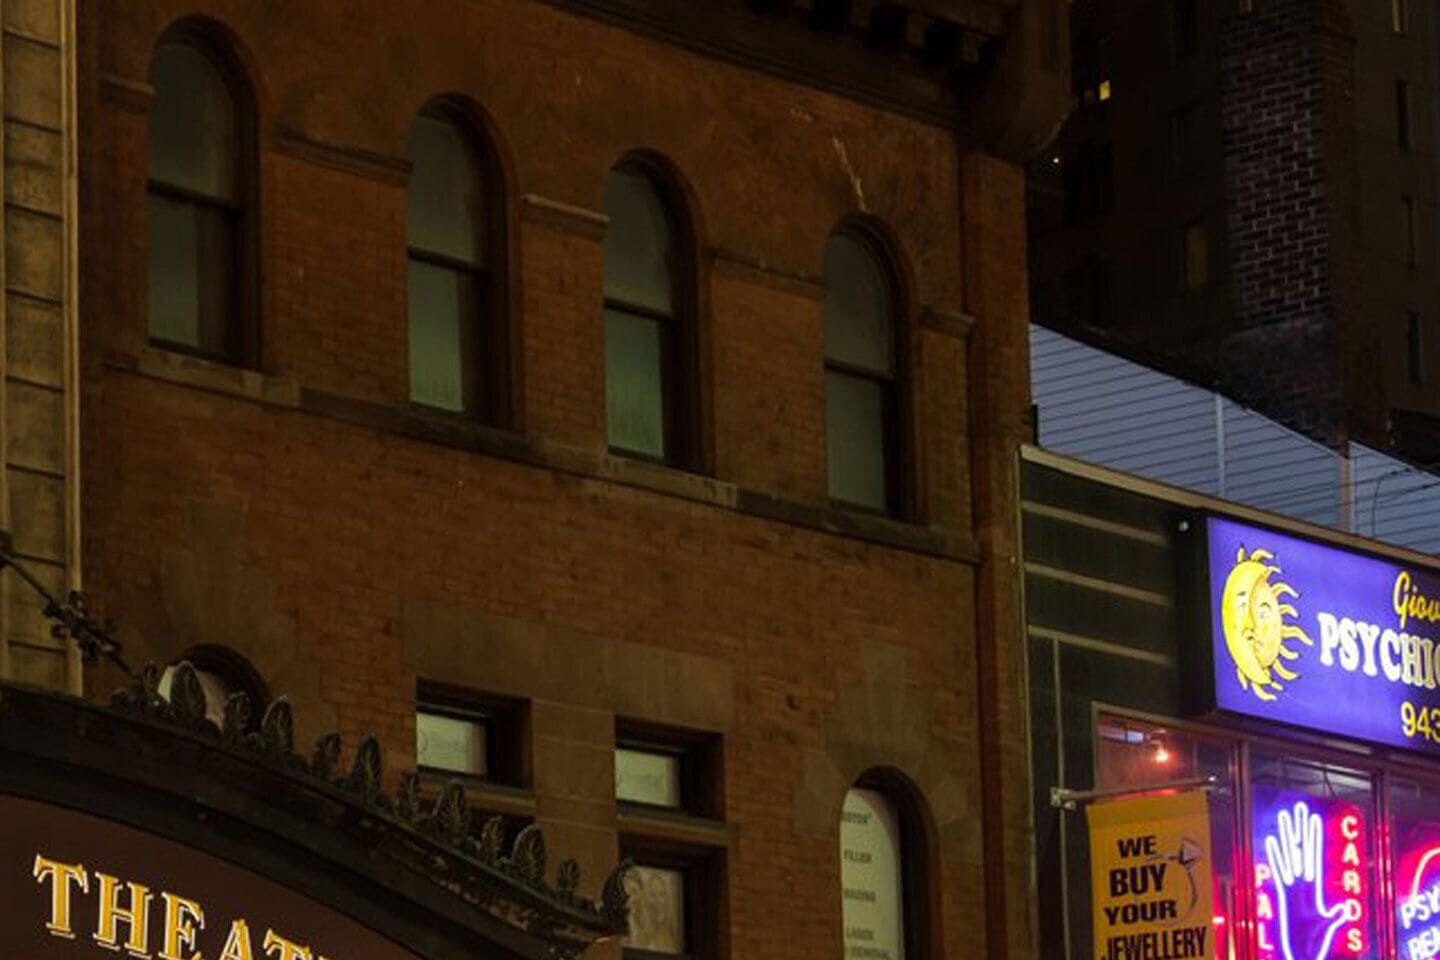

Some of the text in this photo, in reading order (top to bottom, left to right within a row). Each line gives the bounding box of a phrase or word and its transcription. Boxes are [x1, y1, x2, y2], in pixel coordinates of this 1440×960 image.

[1317, 611, 1440, 690] PSYCHI
[1117, 835, 1157, 858] WE
[1109, 863, 1166, 897] BUY
[1339, 813, 1363, 953] CARDS
[1103, 899, 1177, 926] YOUR
